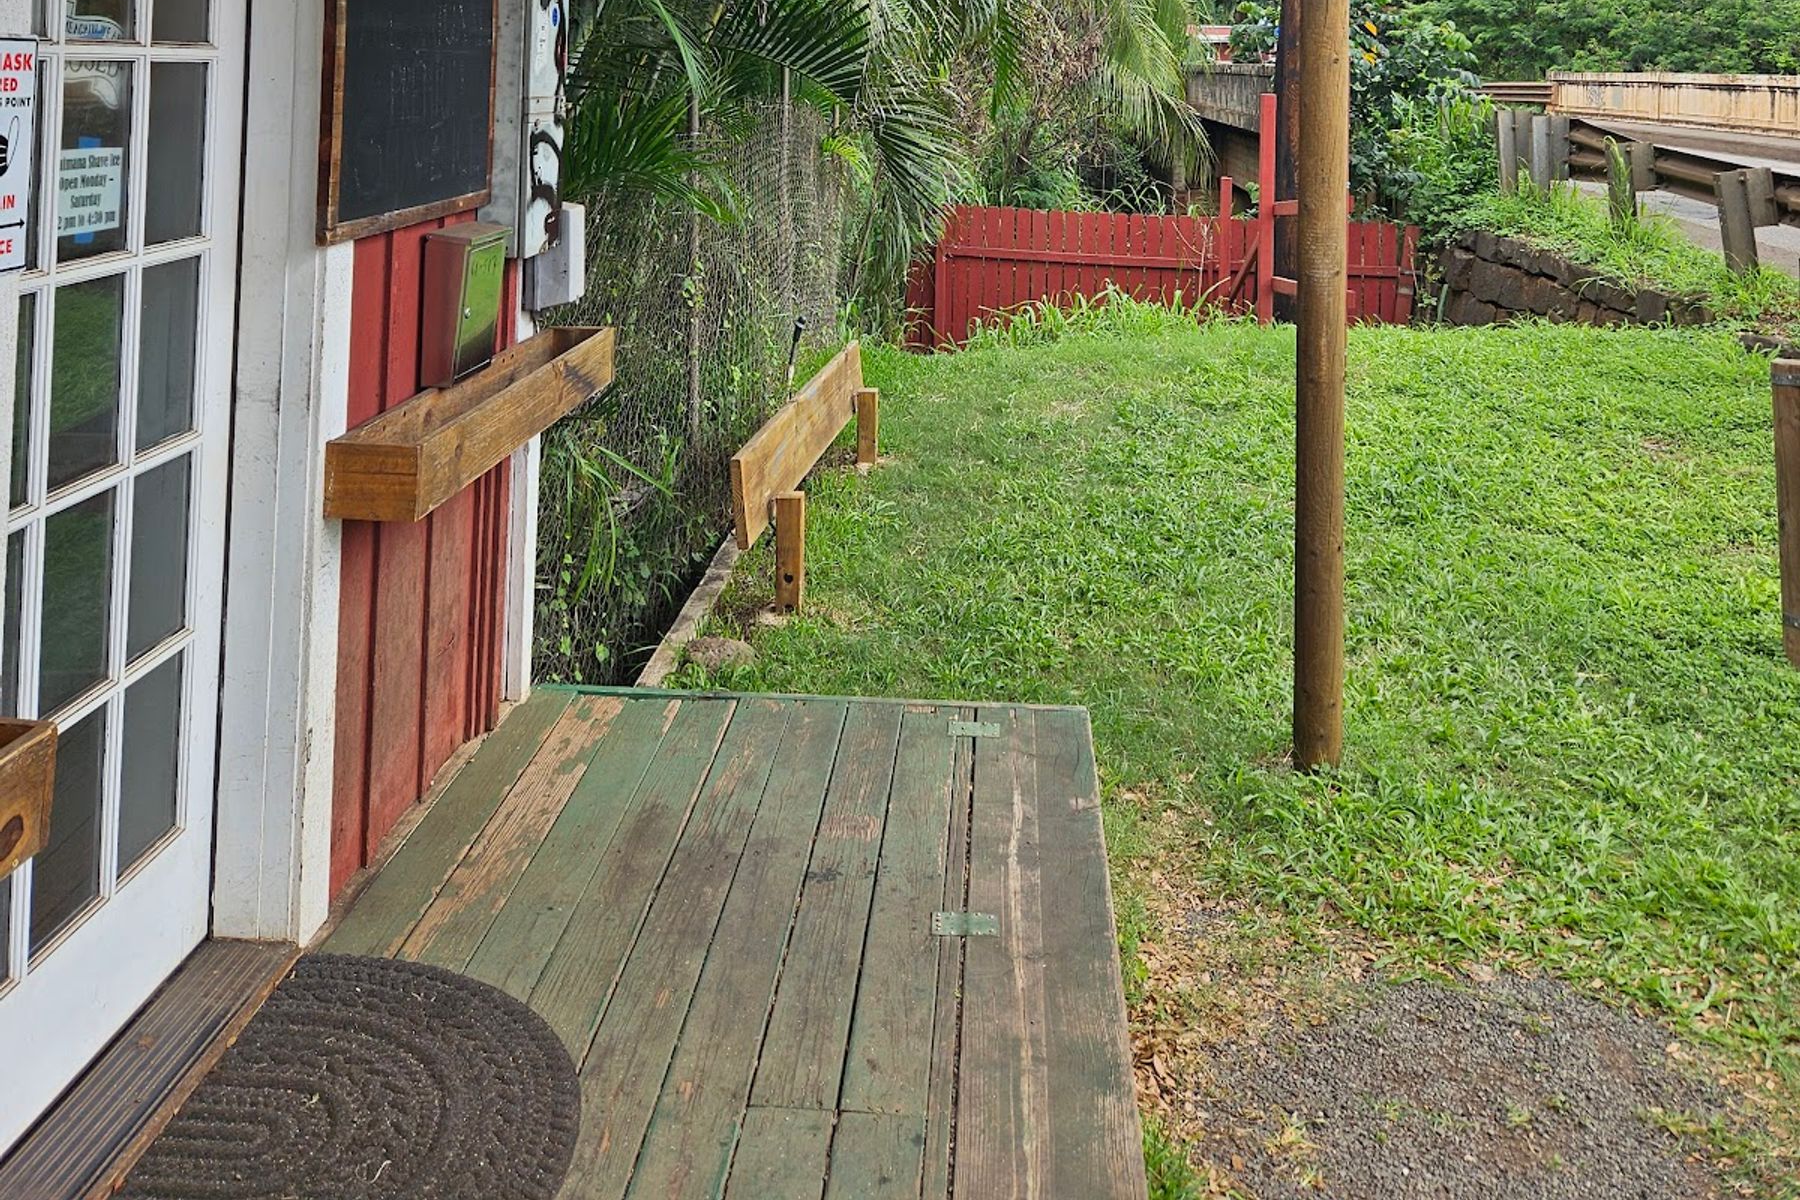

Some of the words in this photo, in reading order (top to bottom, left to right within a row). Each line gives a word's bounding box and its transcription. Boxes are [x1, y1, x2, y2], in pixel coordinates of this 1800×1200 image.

[0, 51, 33, 71] ASK
[5, 97, 31, 107] POINT
[59, 176, 78, 192] Open
[80, 173, 108, 189] Monday
[70, 192, 102, 209] Saturday
[63, 215, 77, 231] pm
[88, 210, 103, 226] 4:30
